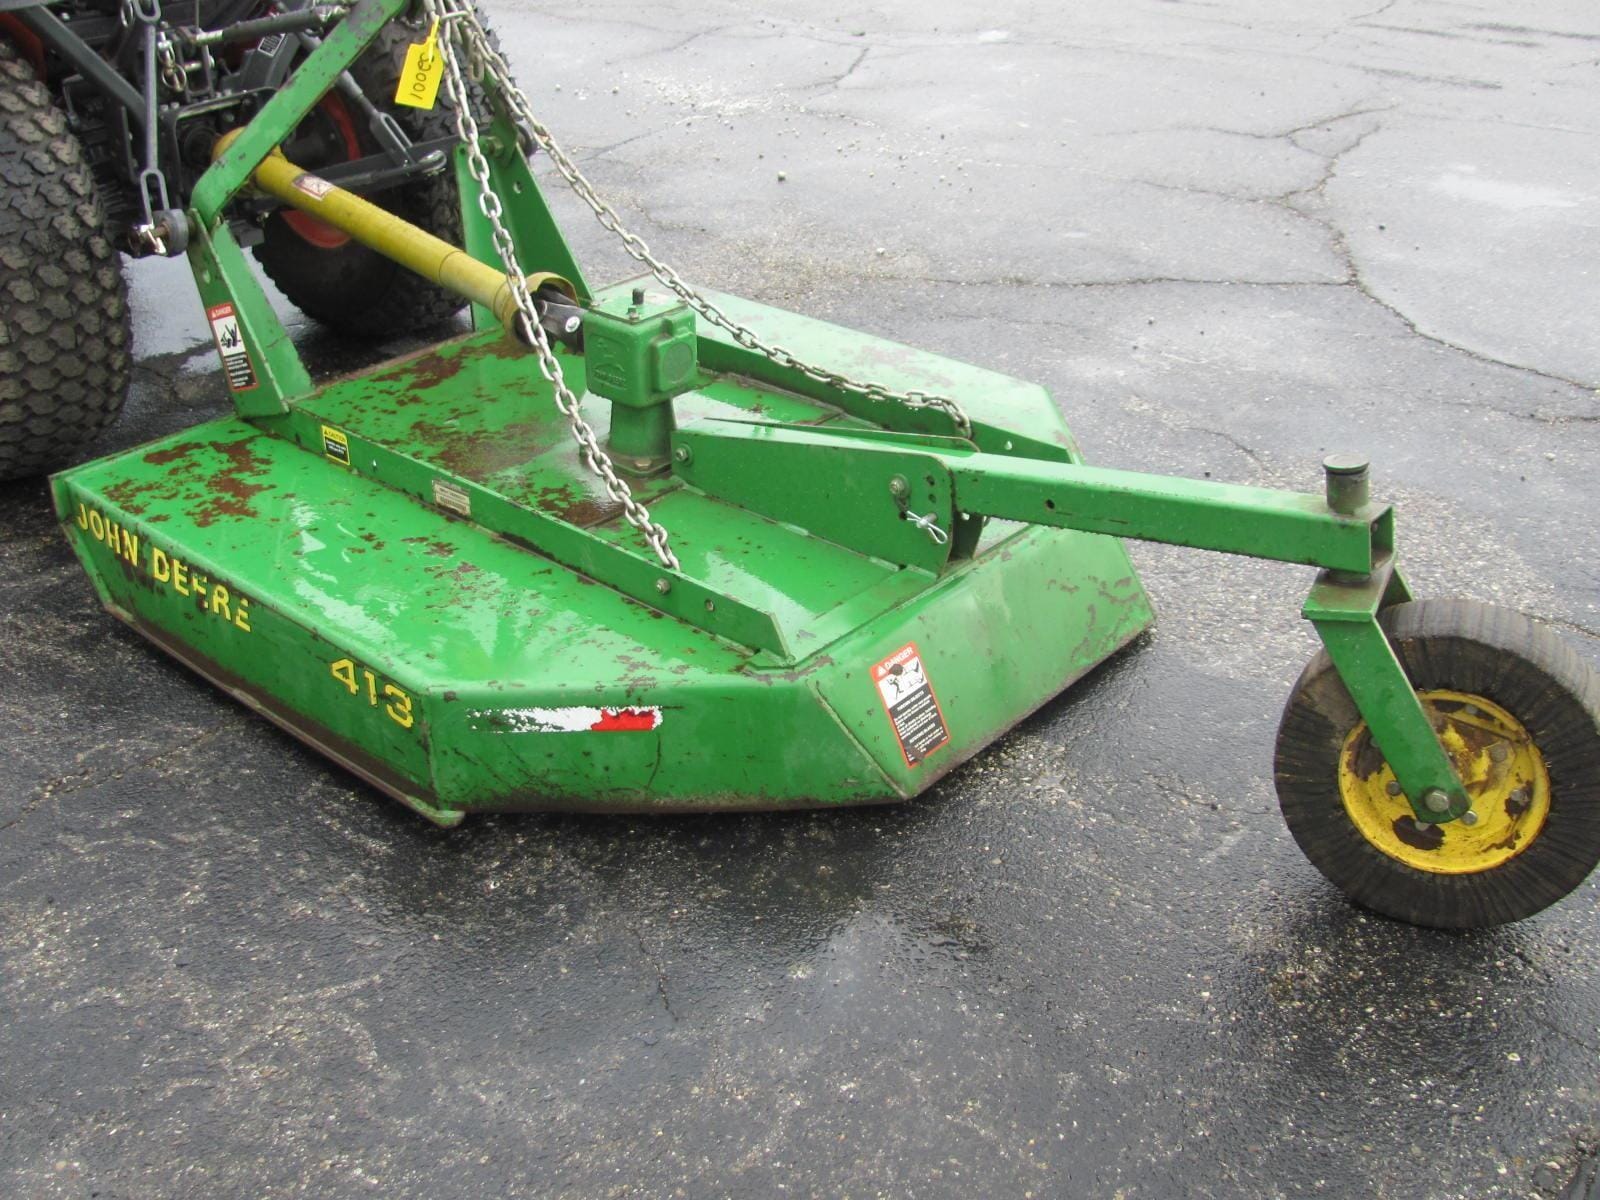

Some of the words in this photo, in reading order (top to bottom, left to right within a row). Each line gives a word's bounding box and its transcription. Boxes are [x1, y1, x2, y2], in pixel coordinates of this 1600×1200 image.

[77, 503, 139, 567] JOHN
[152, 547, 251, 633] DEERE
[884, 646, 914, 669] DANGER
[331, 658, 414, 728] 413
